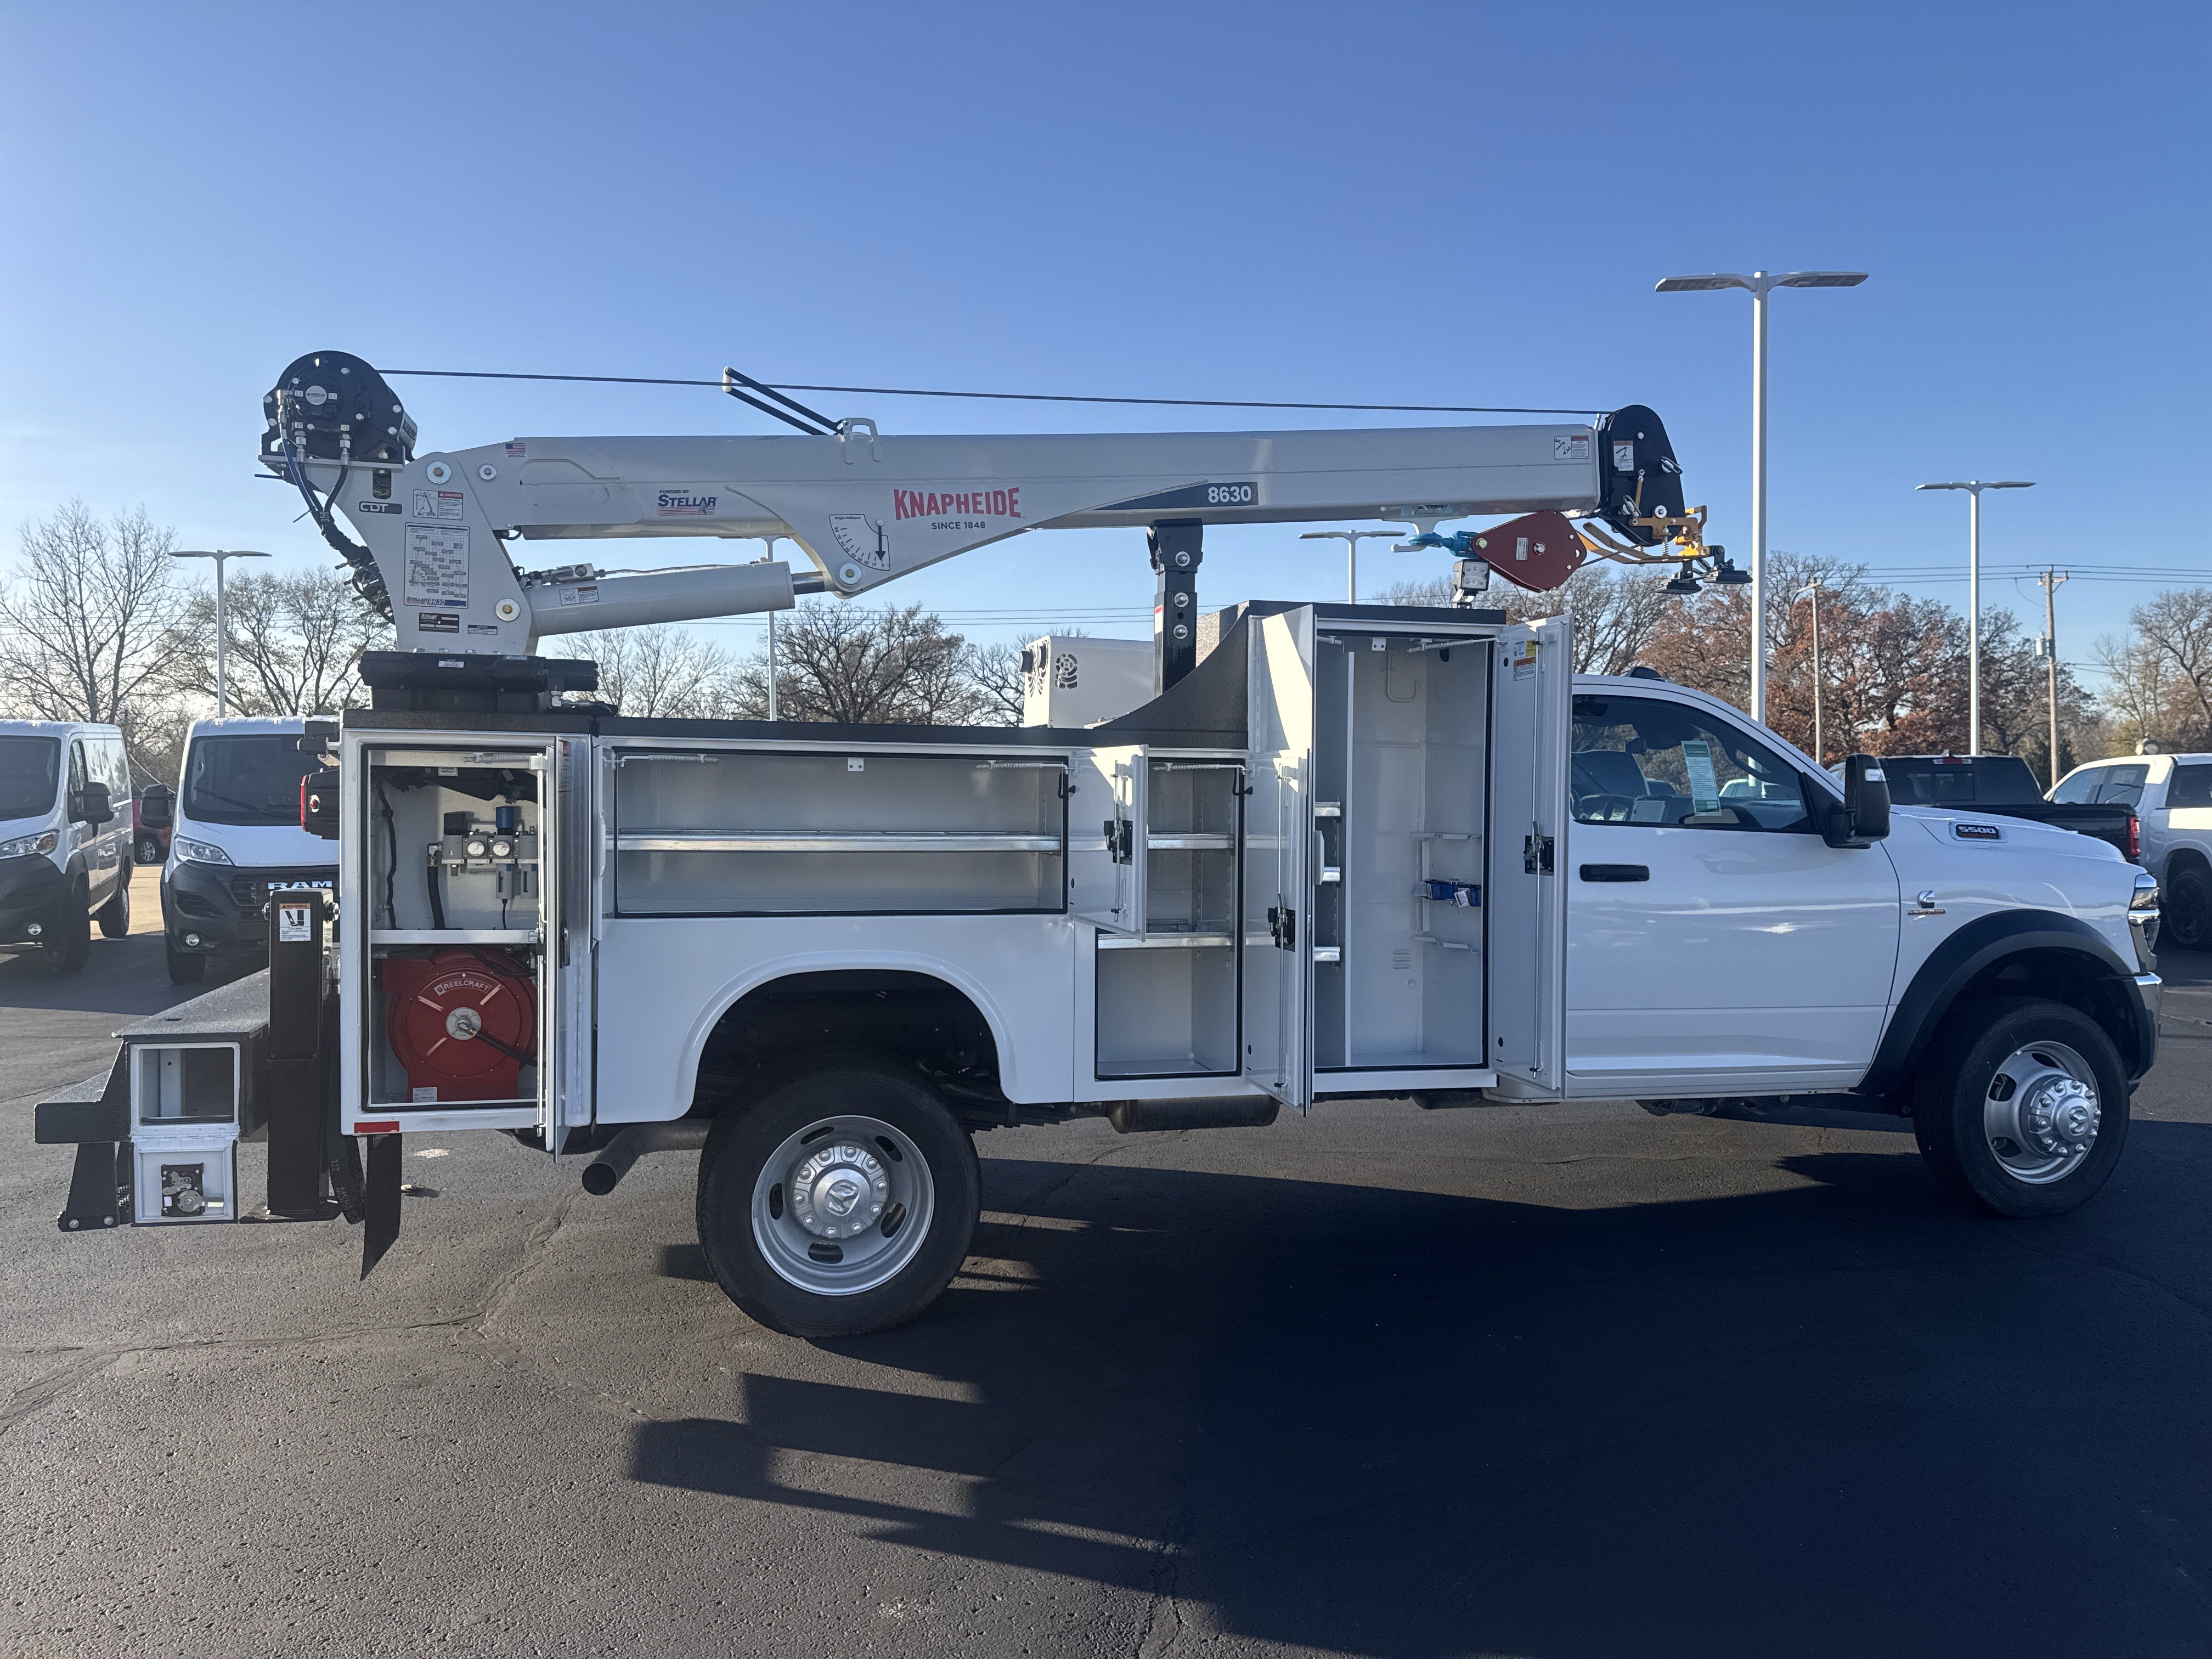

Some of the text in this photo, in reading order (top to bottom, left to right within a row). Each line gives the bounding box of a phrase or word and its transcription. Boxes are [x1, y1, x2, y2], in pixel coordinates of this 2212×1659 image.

[657, 494, 716, 507] STELLAR
[1208, 486, 1252, 503] 8630
[360, 502, 388, 512] CDT
[894, 487, 1022, 521] KNAPHEIDE
[268, 881, 332, 889] RAM
[443, 980, 490, 991] REELCRAFT
